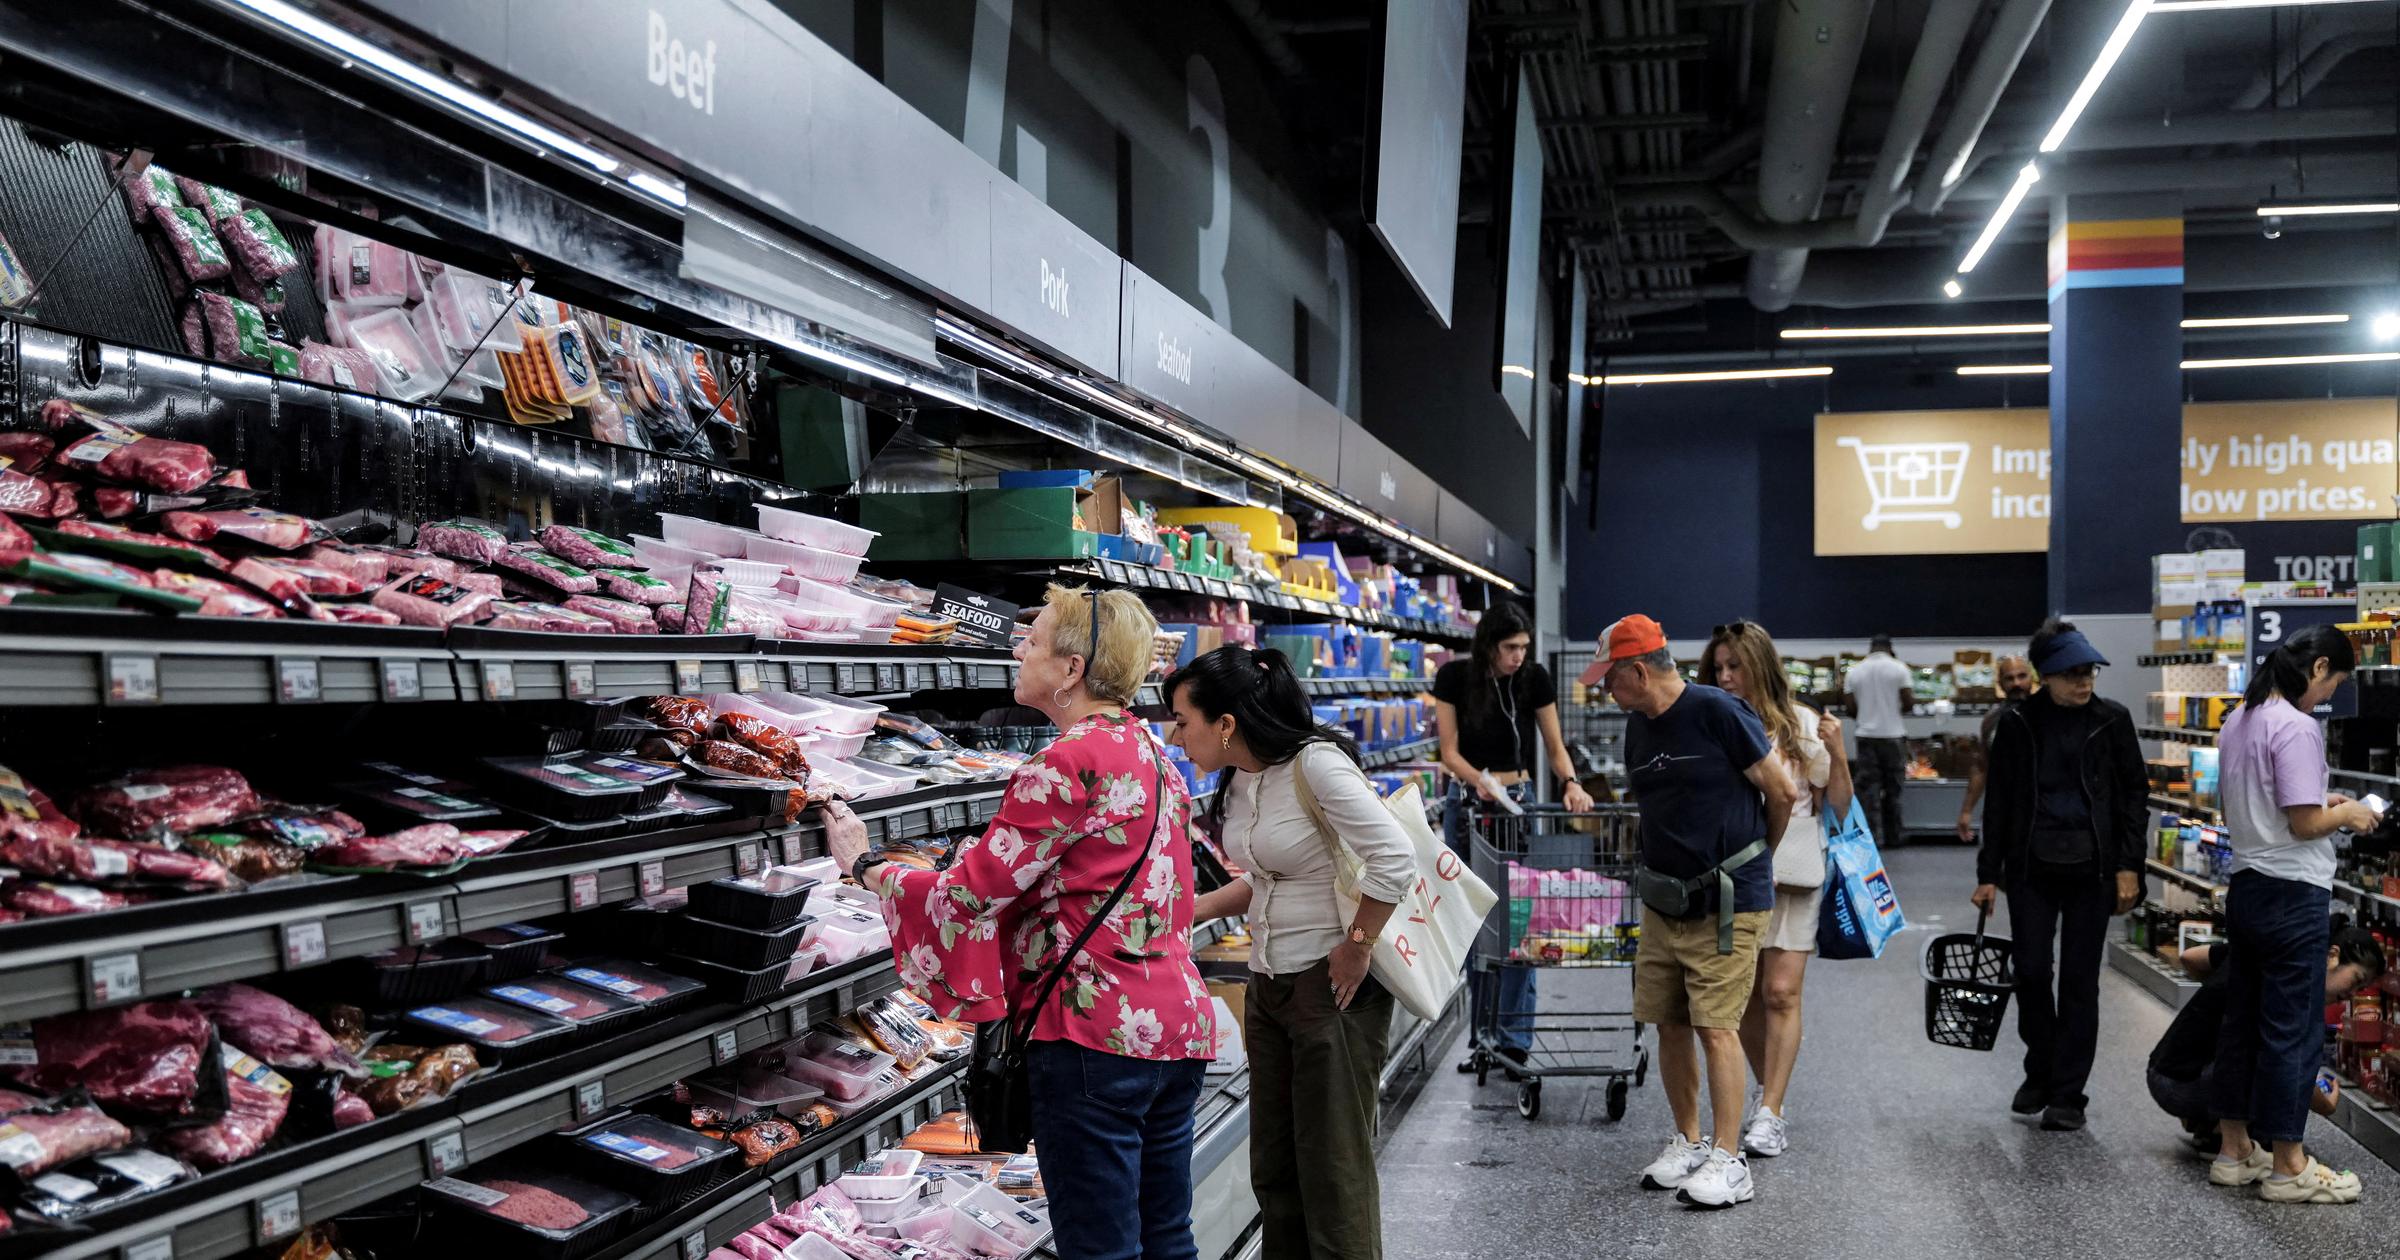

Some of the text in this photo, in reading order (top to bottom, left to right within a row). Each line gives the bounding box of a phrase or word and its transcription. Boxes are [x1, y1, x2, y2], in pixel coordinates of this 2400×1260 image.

[647, 9, 716, 115] Beef
[1040, 258, 1070, 318] Pork
[1157, 331, 1192, 385] Seafood
[2229, 434, 2312, 474] high
[2323, 439, 2393, 473] qua
[2181, 483, 2247, 513] low
[2257, 479, 2376, 520] prices.
[942, 602, 1002, 630] SEAFOOD
[2258, 611, 2282, 642] 3
